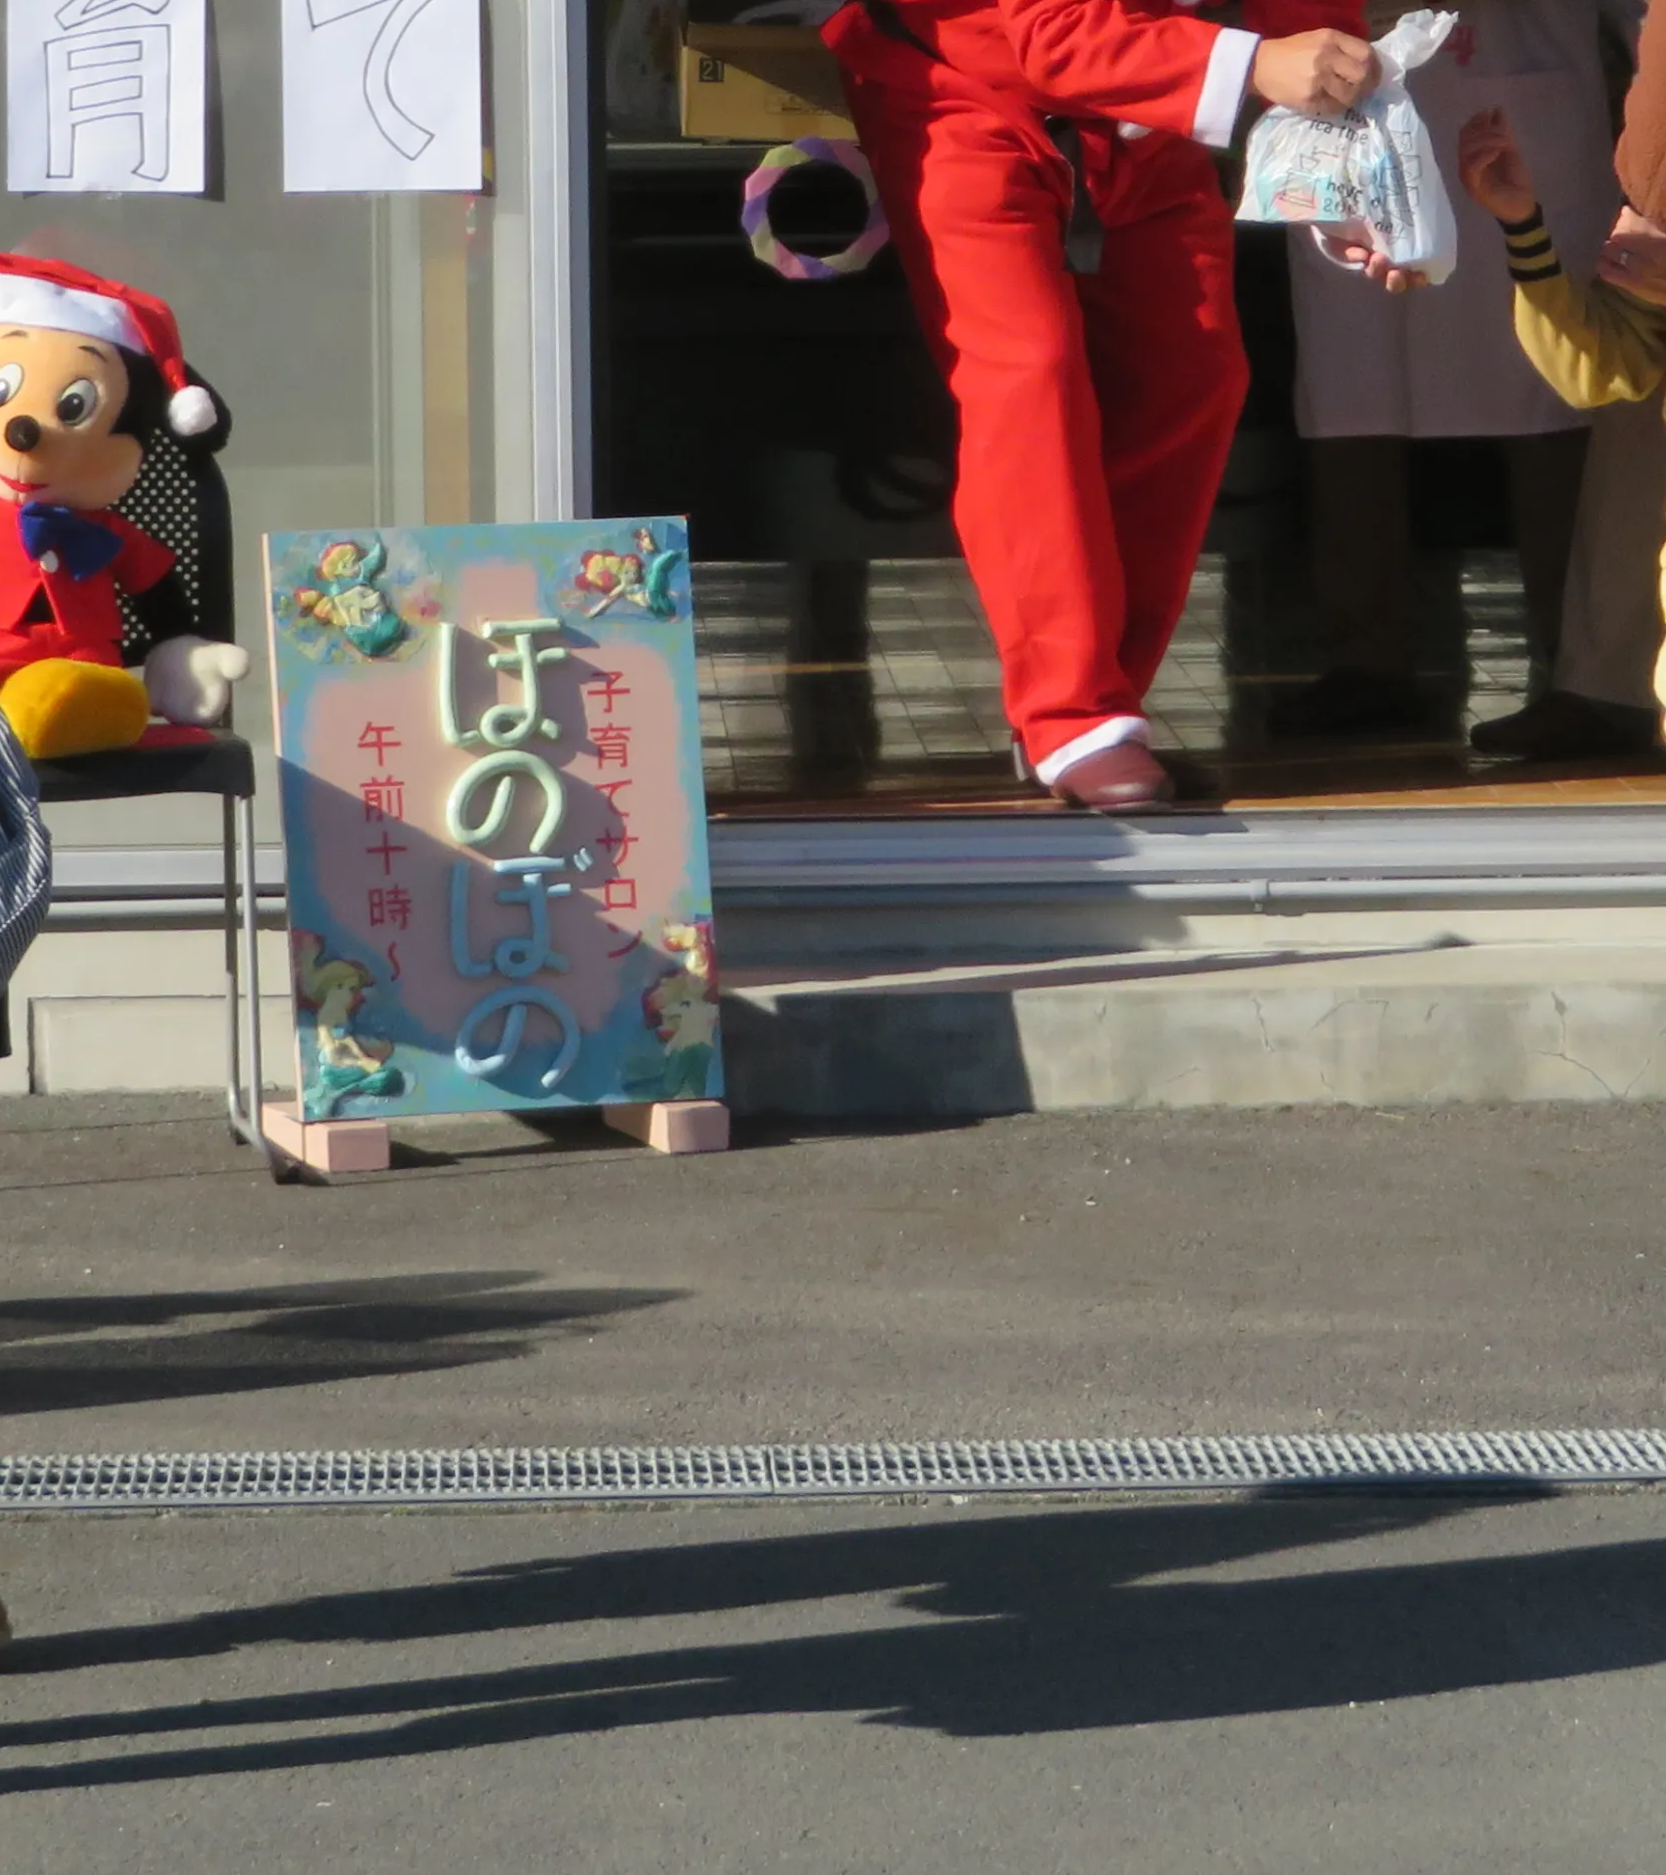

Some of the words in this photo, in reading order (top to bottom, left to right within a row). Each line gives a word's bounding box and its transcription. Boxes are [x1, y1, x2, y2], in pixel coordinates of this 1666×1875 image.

[701, 60, 723, 81] 21
[438, 617, 594, 1090] ほのぼの
[587, 671, 643, 959] 子育てサロン
